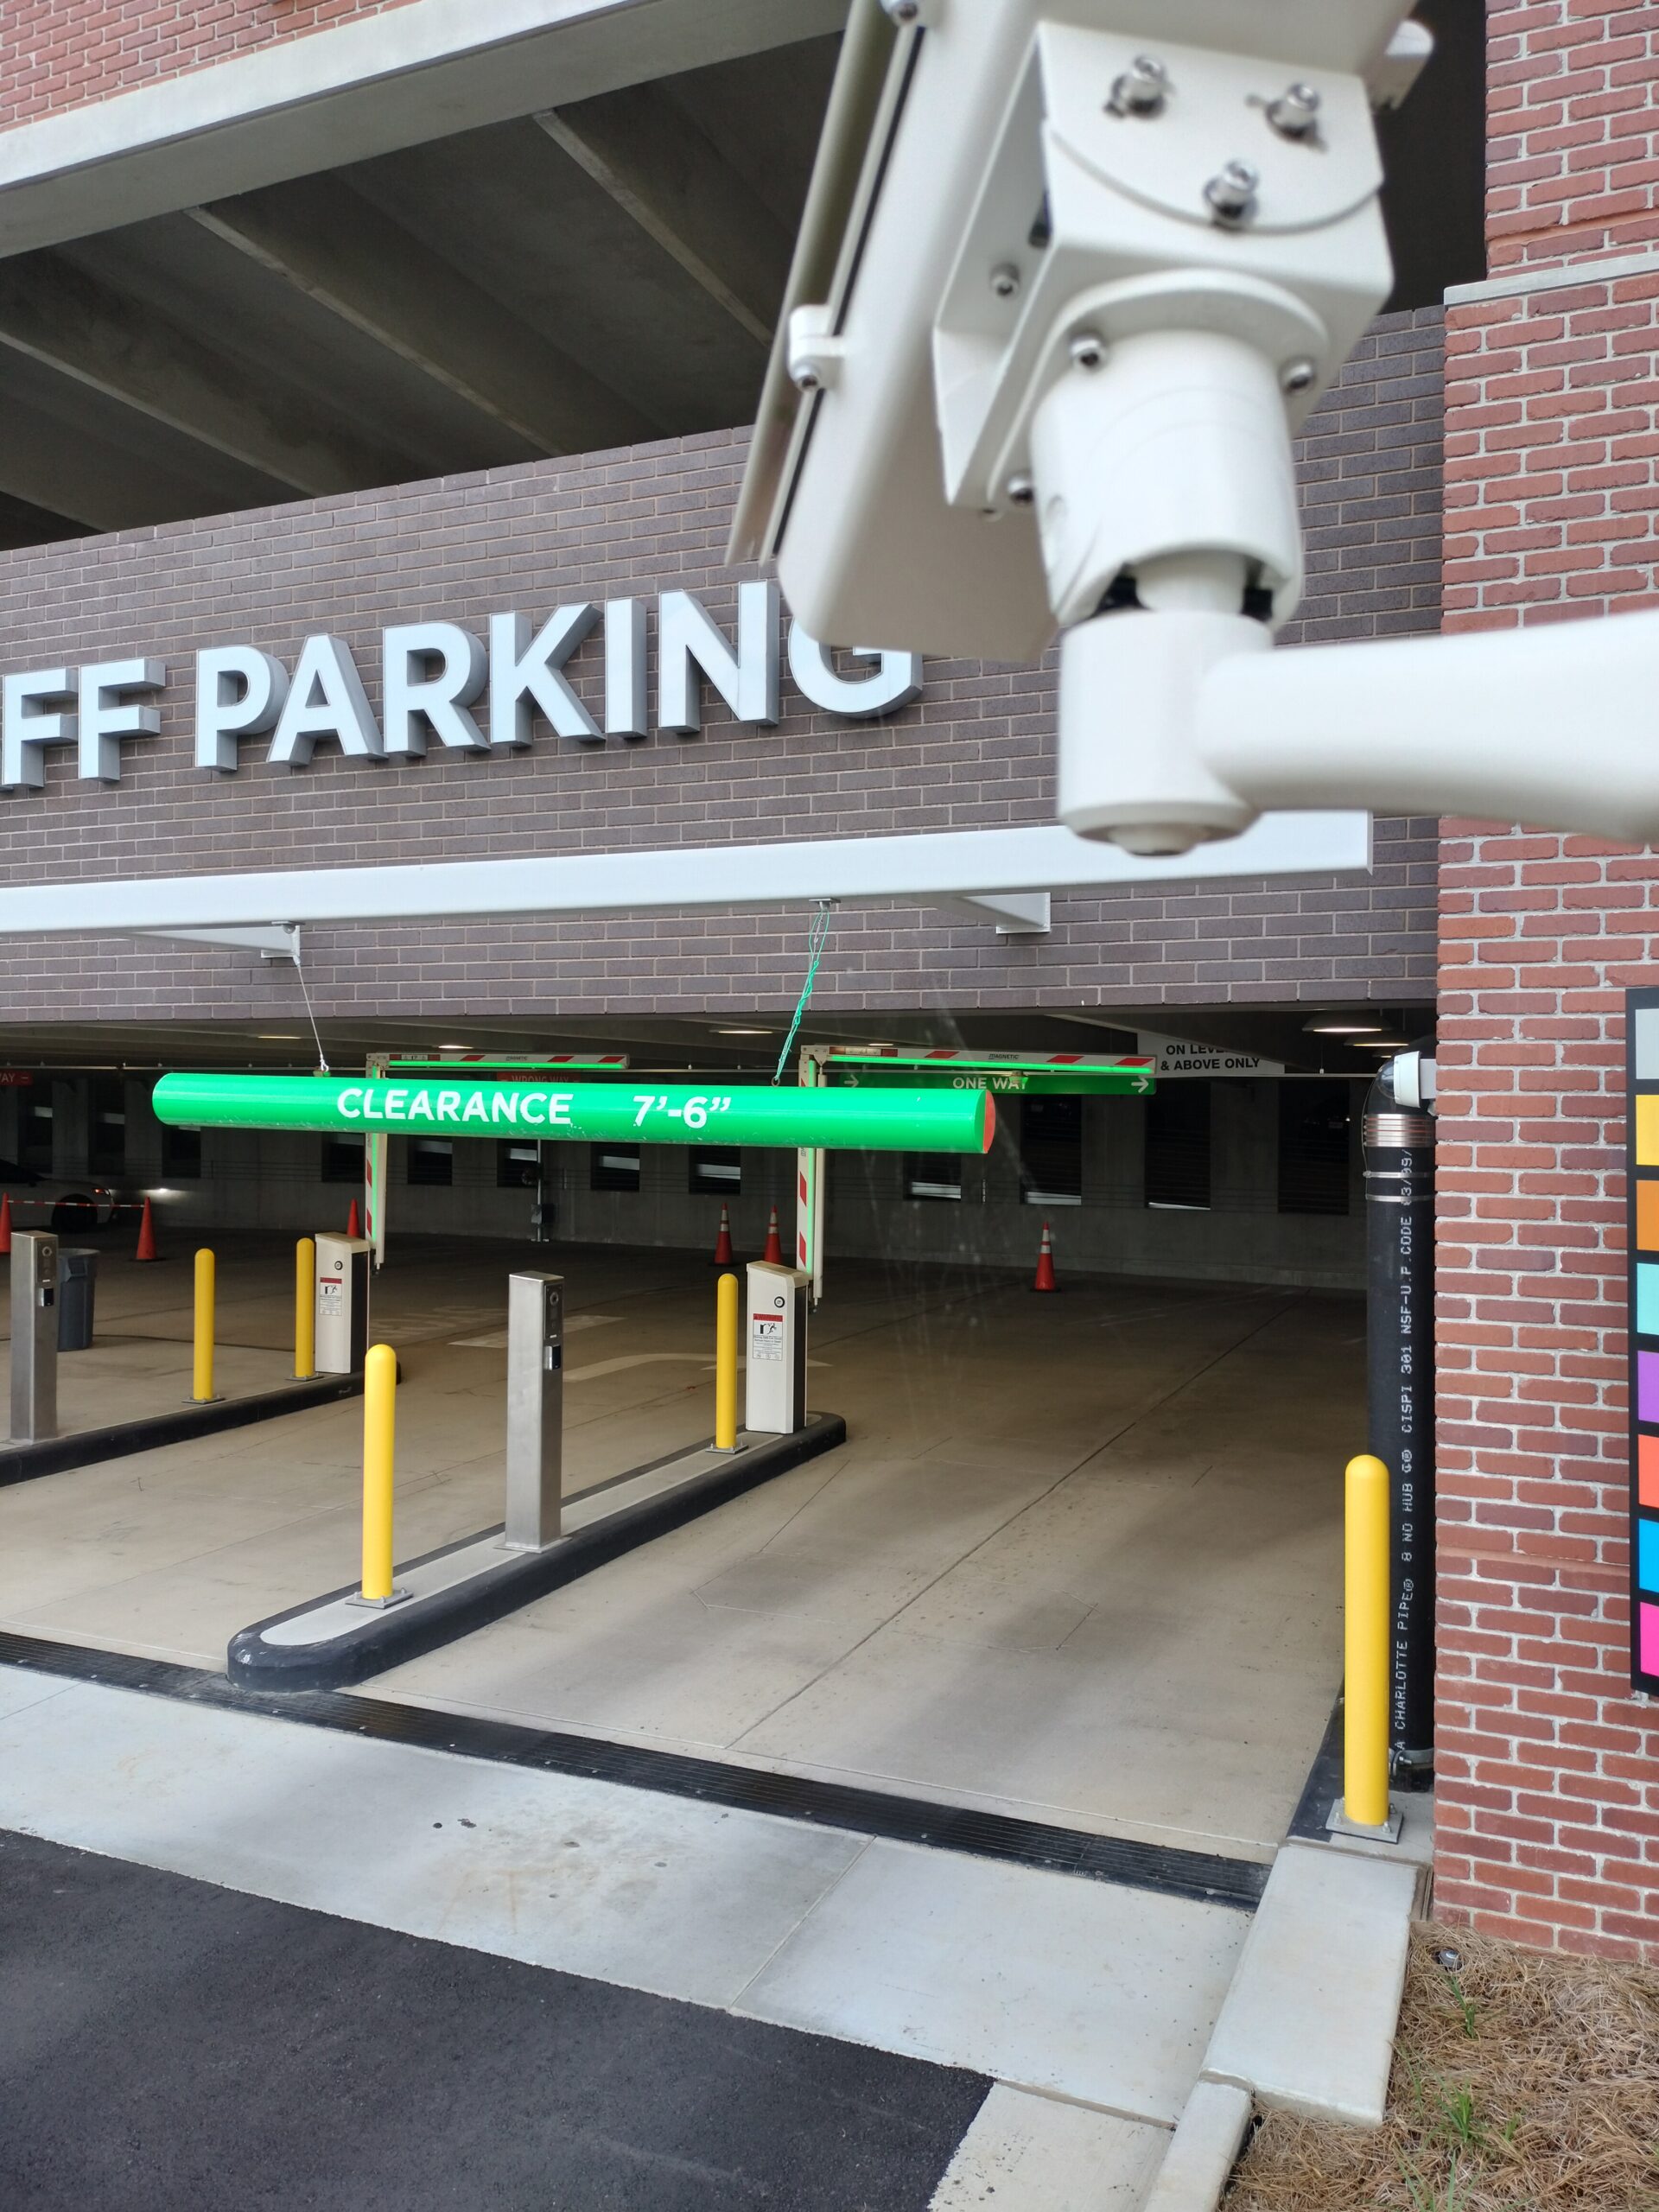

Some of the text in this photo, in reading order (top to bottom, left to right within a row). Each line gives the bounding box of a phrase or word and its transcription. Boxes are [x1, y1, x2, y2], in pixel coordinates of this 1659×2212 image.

[195, 578, 922, 772] PARKING
[1166, 1044, 1230, 1055] ON LEV
[1160, 1058, 1260, 1071] & ABOVE ONLY
[0, 1072, 16, 1083] AY
[952, 1077, 987, 1090] ONE
[337, 1088, 574, 1124] CLEARANCE
[1401, 1344, 1413, 1375] 301
[1401, 1385, 1413, 1433] CISPI
[1402, 1483, 1413, 1513] HUB
[1402, 1522, 1413, 1542] NO
[1402, 1551, 1413, 1562] 8
[1394, 1640, 1408, 1730] CHARLOTTE
